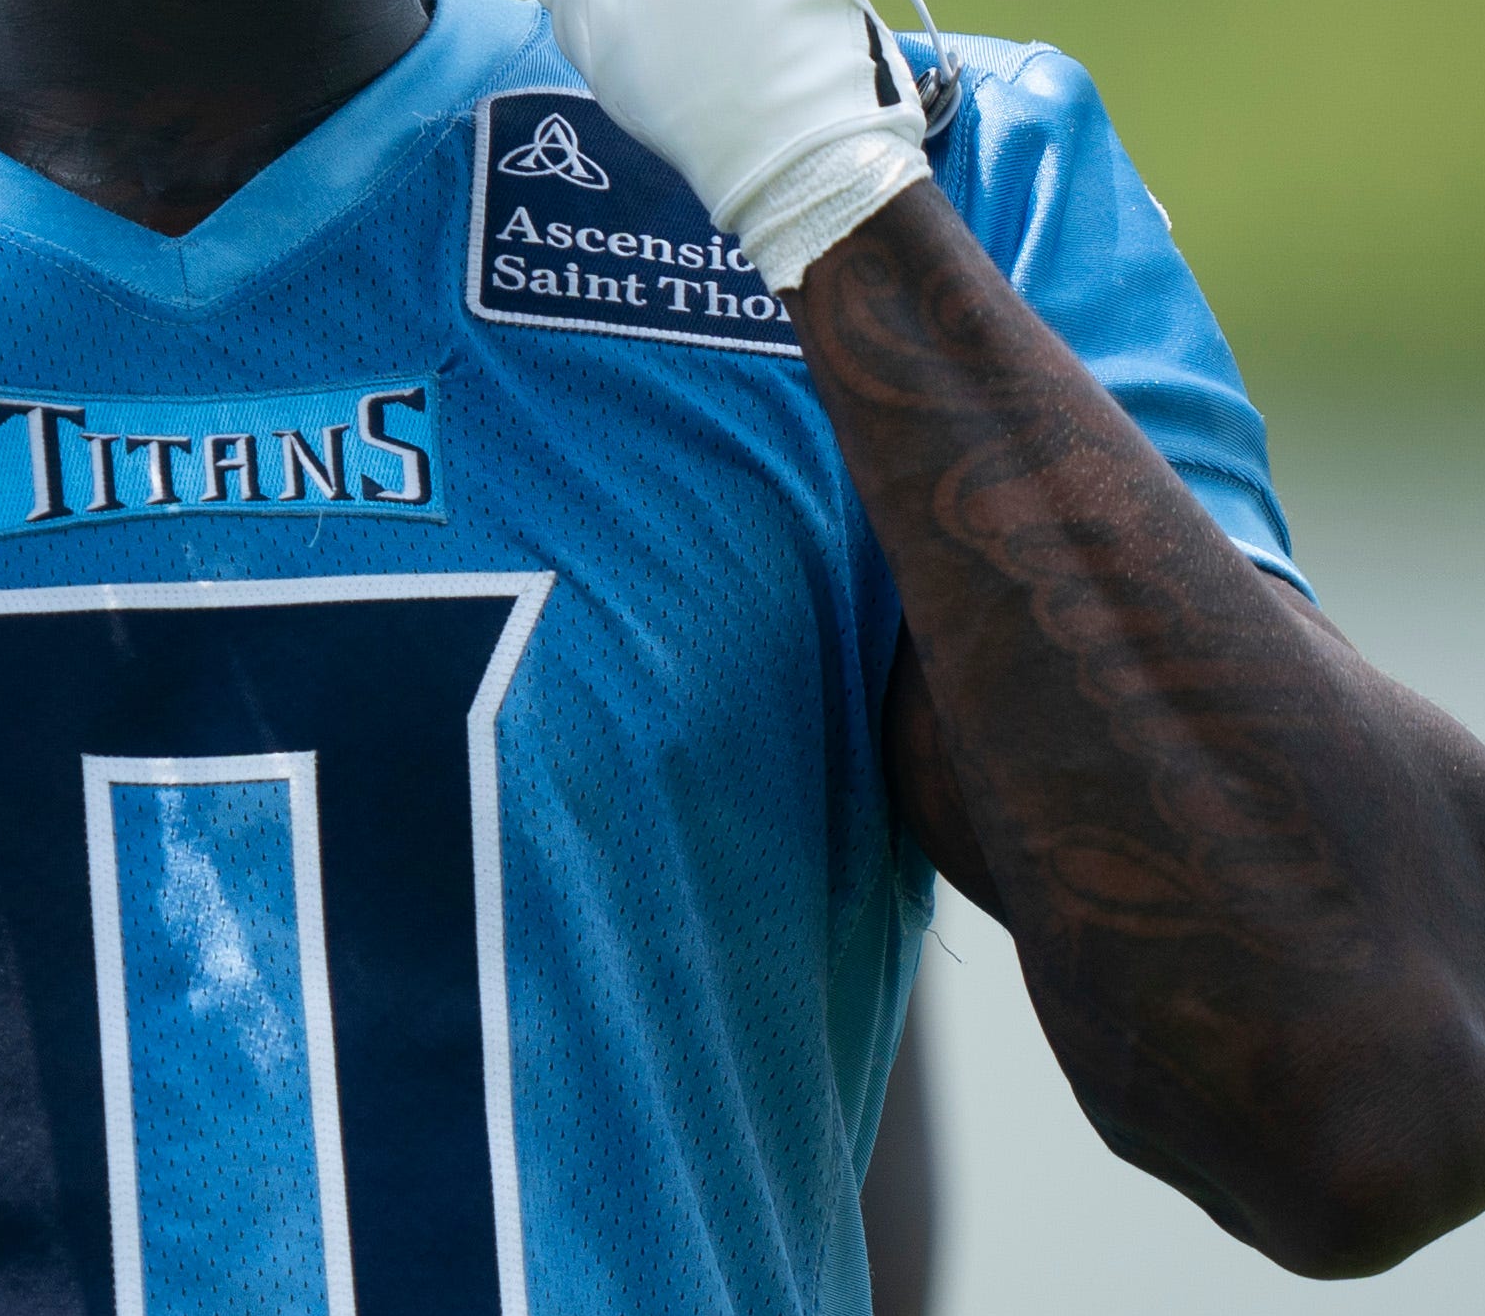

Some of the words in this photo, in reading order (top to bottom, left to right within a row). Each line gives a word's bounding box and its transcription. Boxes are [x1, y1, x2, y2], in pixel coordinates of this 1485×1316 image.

[495, 205, 756, 272] Ascensio
[491, 253, 648, 307] Saint
[656, 275, 792, 323] Tho
